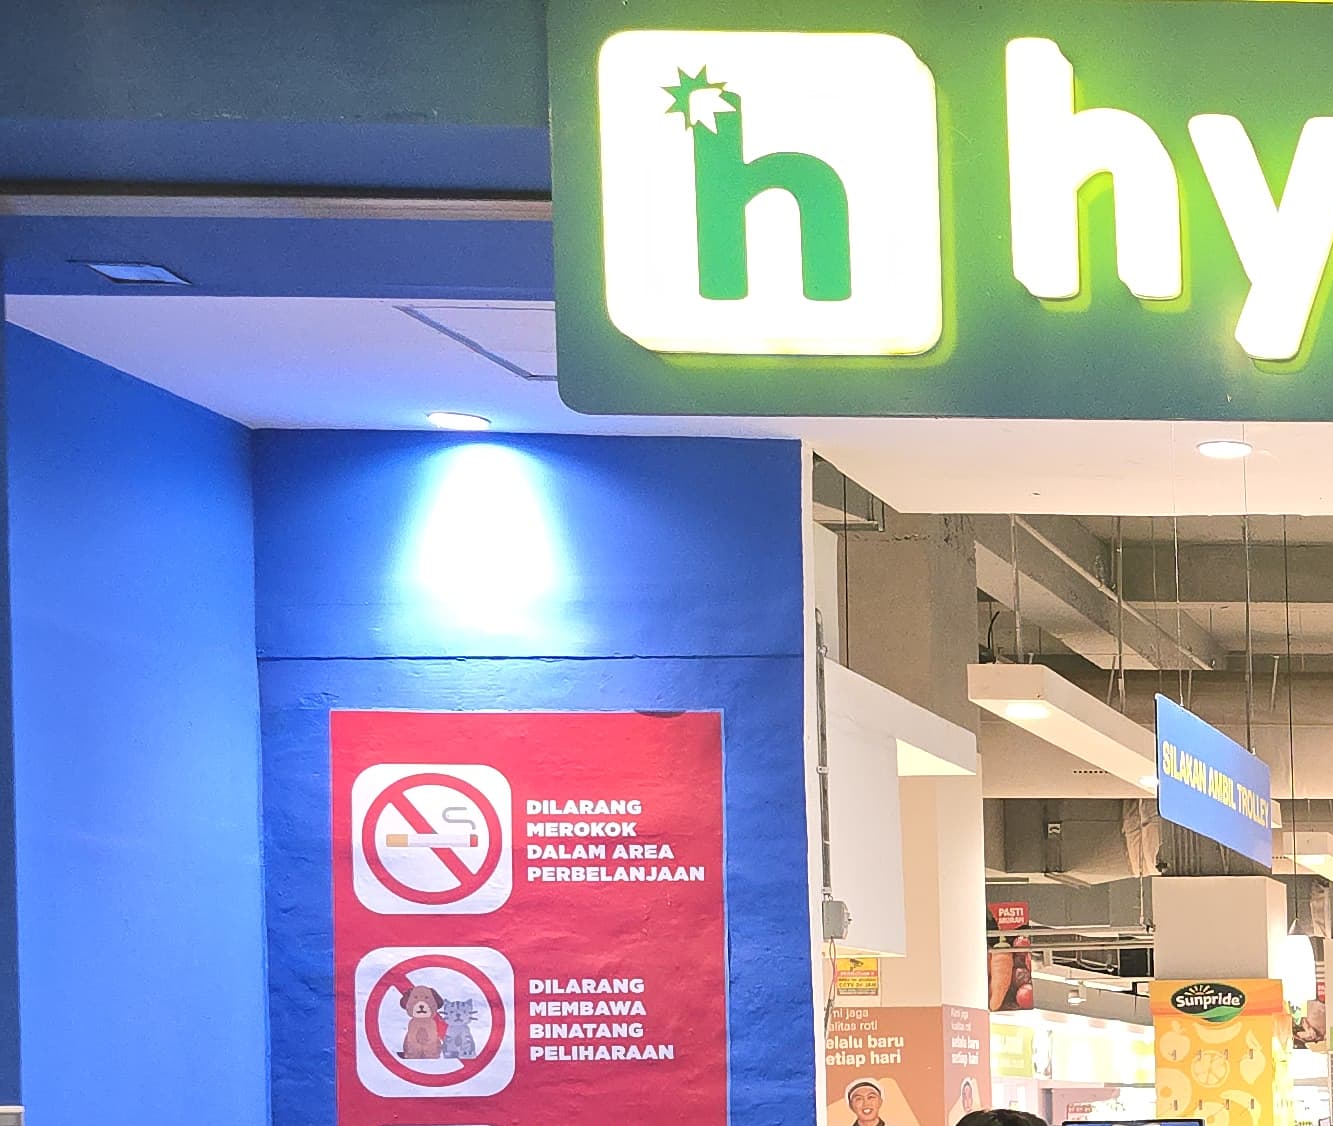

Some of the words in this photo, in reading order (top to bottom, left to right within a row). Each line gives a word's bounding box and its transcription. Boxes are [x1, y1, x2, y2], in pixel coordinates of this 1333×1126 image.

[1162, 740, 1207, 794] SILAKAN
[1208, 766, 1236, 811] AMBIL
[1237, 783, 1269, 828] TROLLEY
[526, 799, 642, 816] DILARANG
[526, 821, 636, 838] MEROKOK
[526, 843, 607, 861] DALAM
[612, 843, 674, 860] AREA
[526, 865, 705, 883] PERBELANJAAN
[998, 907, 1024, 917] PASTI
[528, 978, 645, 995] DILARANG
[528, 1000, 647, 1017] MEMBAWA
[1175, 992, 1241, 1010] Sunpride
[529, 1022, 644, 1039] BINATANG
[828, 1021, 857, 1031] alitas
[826, 1035, 863, 1049] elalu
[867, 1034, 904, 1048] baru
[529, 1044, 675, 1062] PELIHARAAN
[826, 1051, 866, 1067] etiap
[870, 1049, 901, 1065] hari
